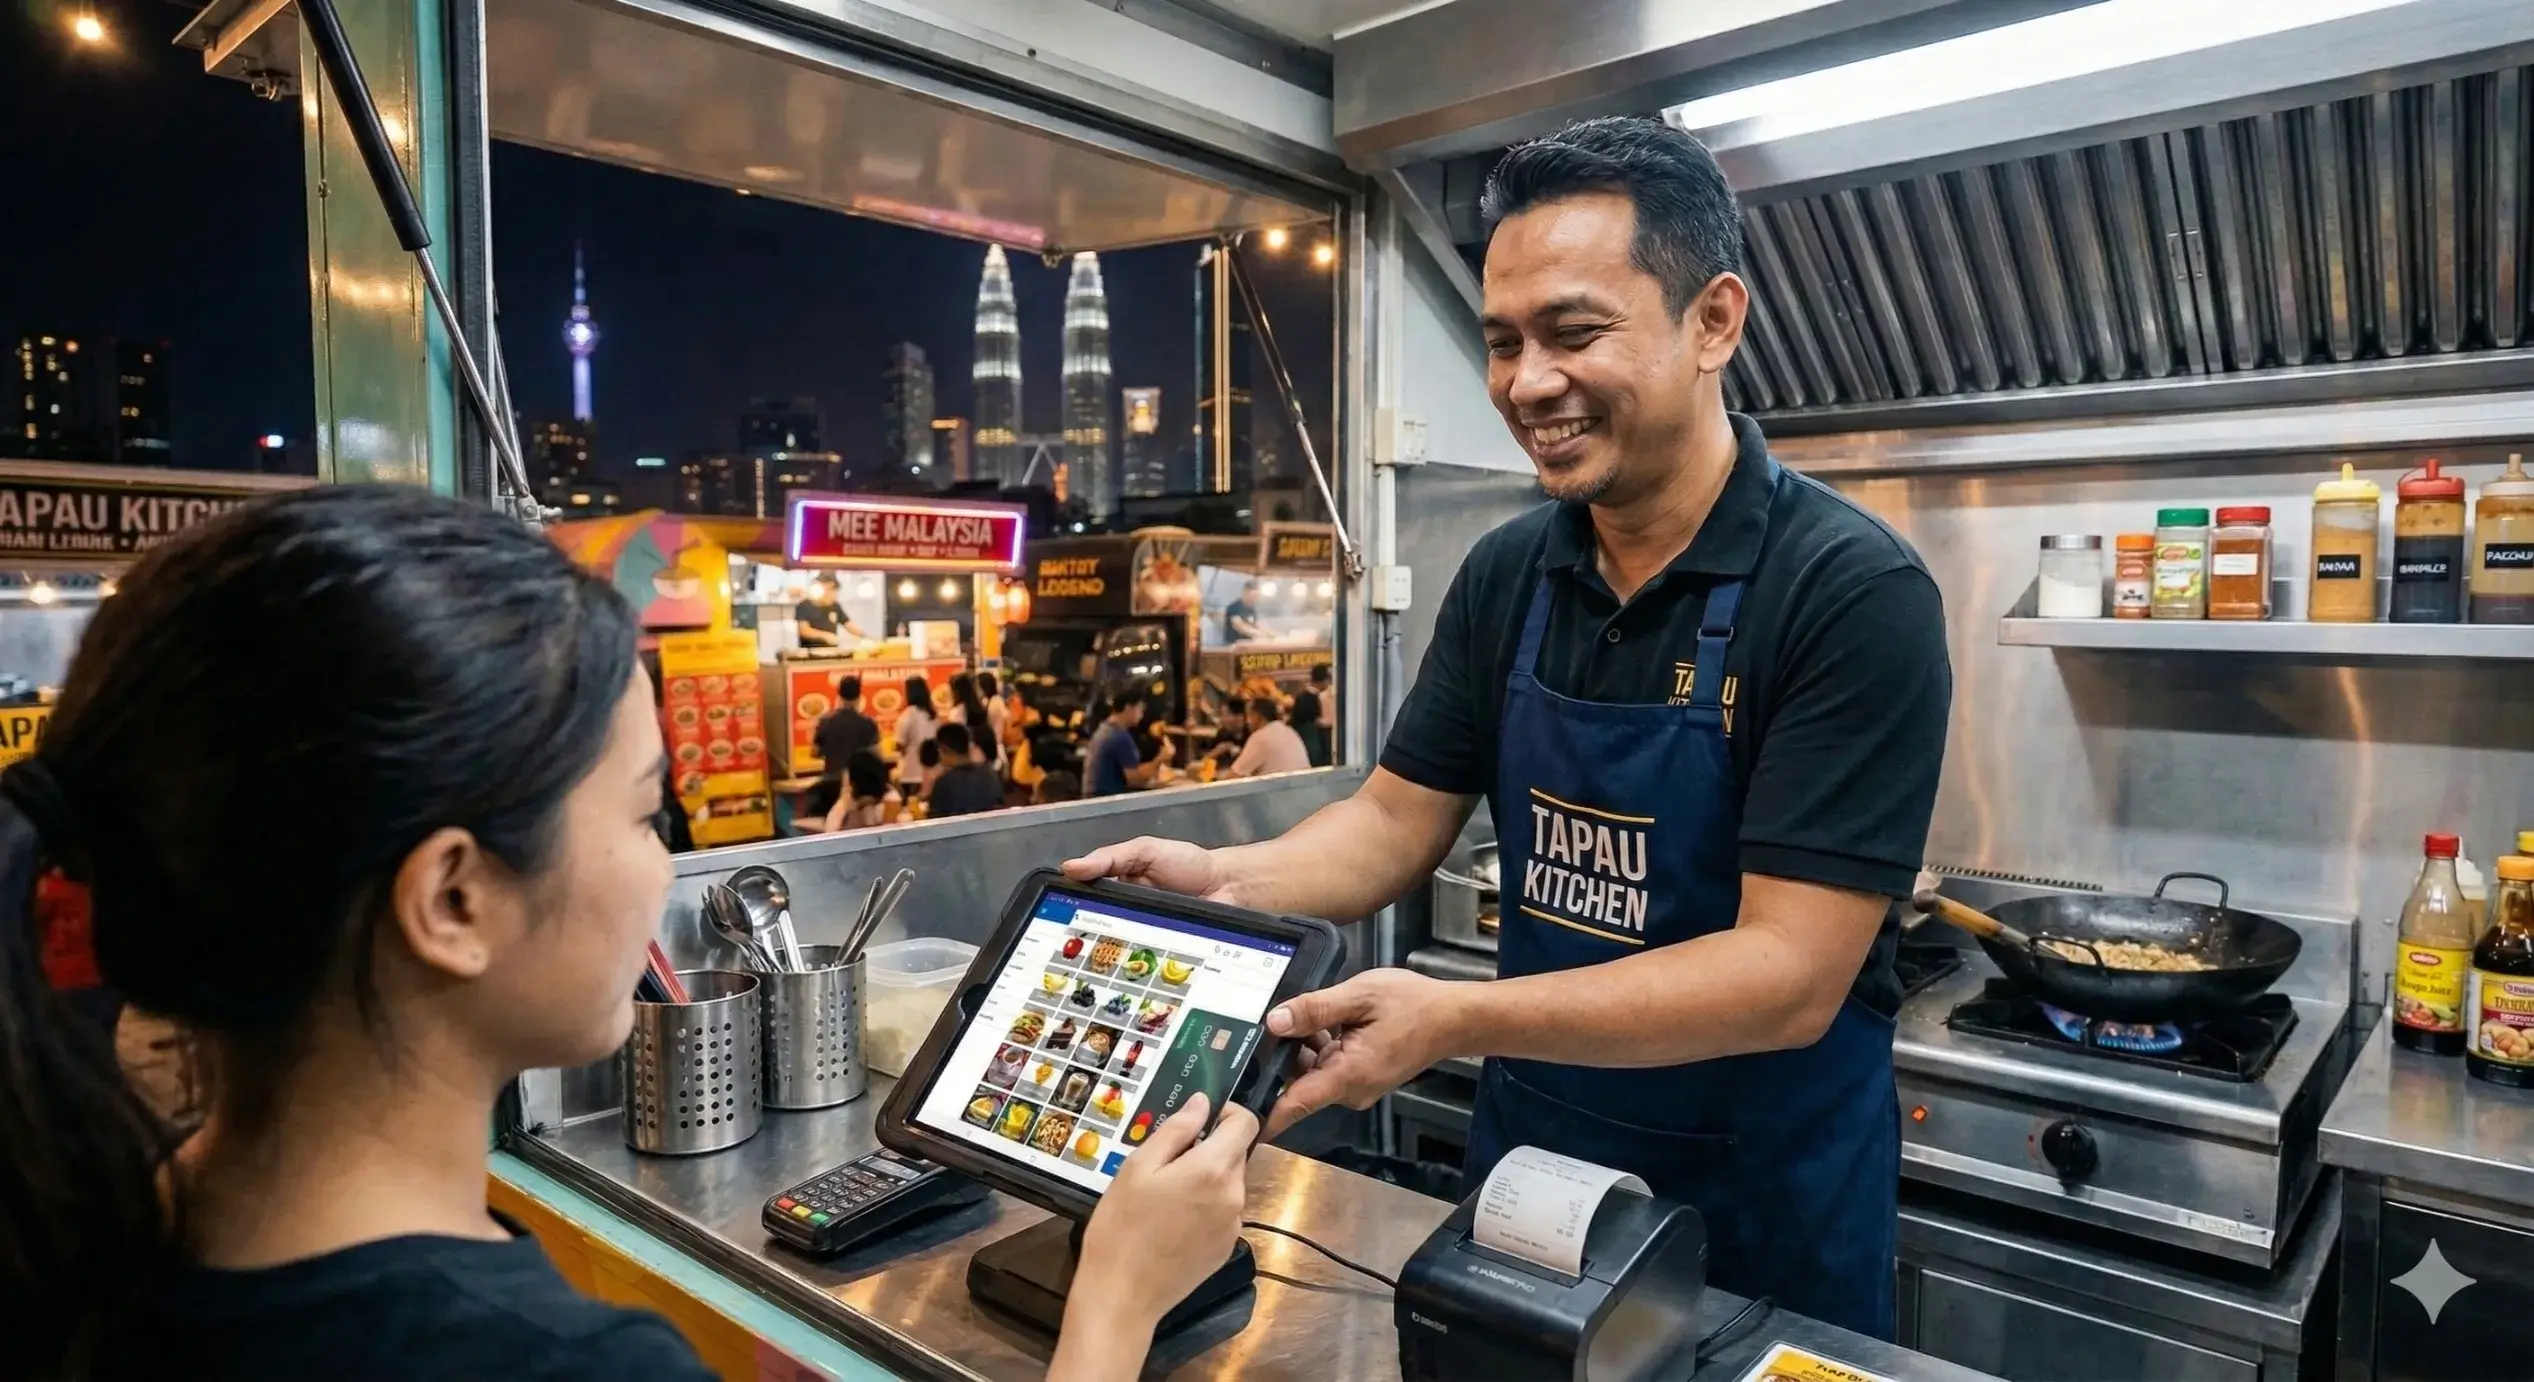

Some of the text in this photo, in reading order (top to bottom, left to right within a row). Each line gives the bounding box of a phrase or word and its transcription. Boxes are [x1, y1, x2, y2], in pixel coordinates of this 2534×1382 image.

[828, 510, 993, 547] MEE MALAYSIA
[1675, 669, 1738, 705] TAU
[1532, 804, 1648, 881] TAPAU
[1523, 858, 1649, 931] KITCHEN
